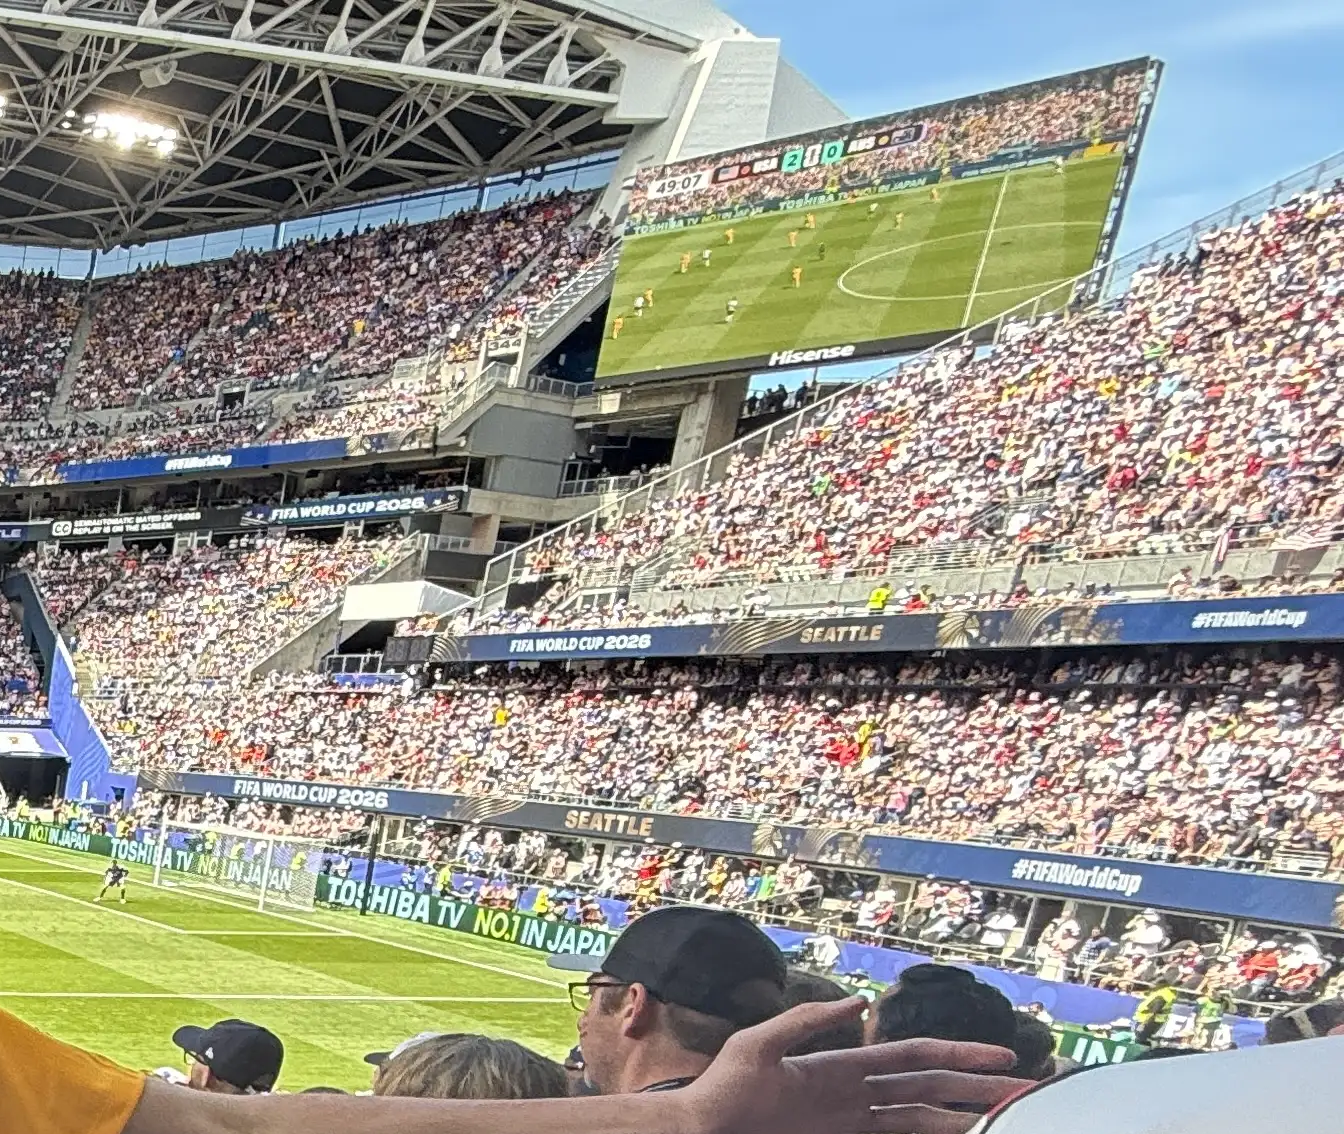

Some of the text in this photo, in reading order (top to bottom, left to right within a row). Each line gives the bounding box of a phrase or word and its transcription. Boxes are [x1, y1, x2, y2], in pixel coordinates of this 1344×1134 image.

[787, 155, 798, 167] 2
[828, 146, 837, 159] 0
[753, 158, 778, 174] USA
[656, 174, 703, 194] 49:07
[780, 191, 834, 211] TOSHIBA
[634, 216, 683, 235] TOSHIBA
[687, 216, 699, 226] TV
[768, 345, 856, 366] Hisense
[271, 497, 424, 521] FIFA WORLD CUP 2026
[126, 523, 140, 532] THE
[1191, 608, 1307, 629] #FIFAWorldCup
[510, 634, 651, 653] FIFA WORLD CUP 2026
[800, 624, 884, 644] SEATTLE
[234, 779, 389, 809] FIFA WORLD CUP 2026
[564, 809, 654, 837] SEATTLE
[12, 820, 27, 838] TV
[48, 828, 59, 845] IN
[59, 829, 90, 851] JAPAN
[175, 850, 194, 872] TV
[244, 863, 292, 891] JAAN
[1012, 857, 1143, 897] #FIFAWorldCup
[436, 900, 465, 929] TV
[473, 908, 519, 942] NO.1
[520, 918, 547, 948] IN
[548, 924, 615, 957] JAPA
